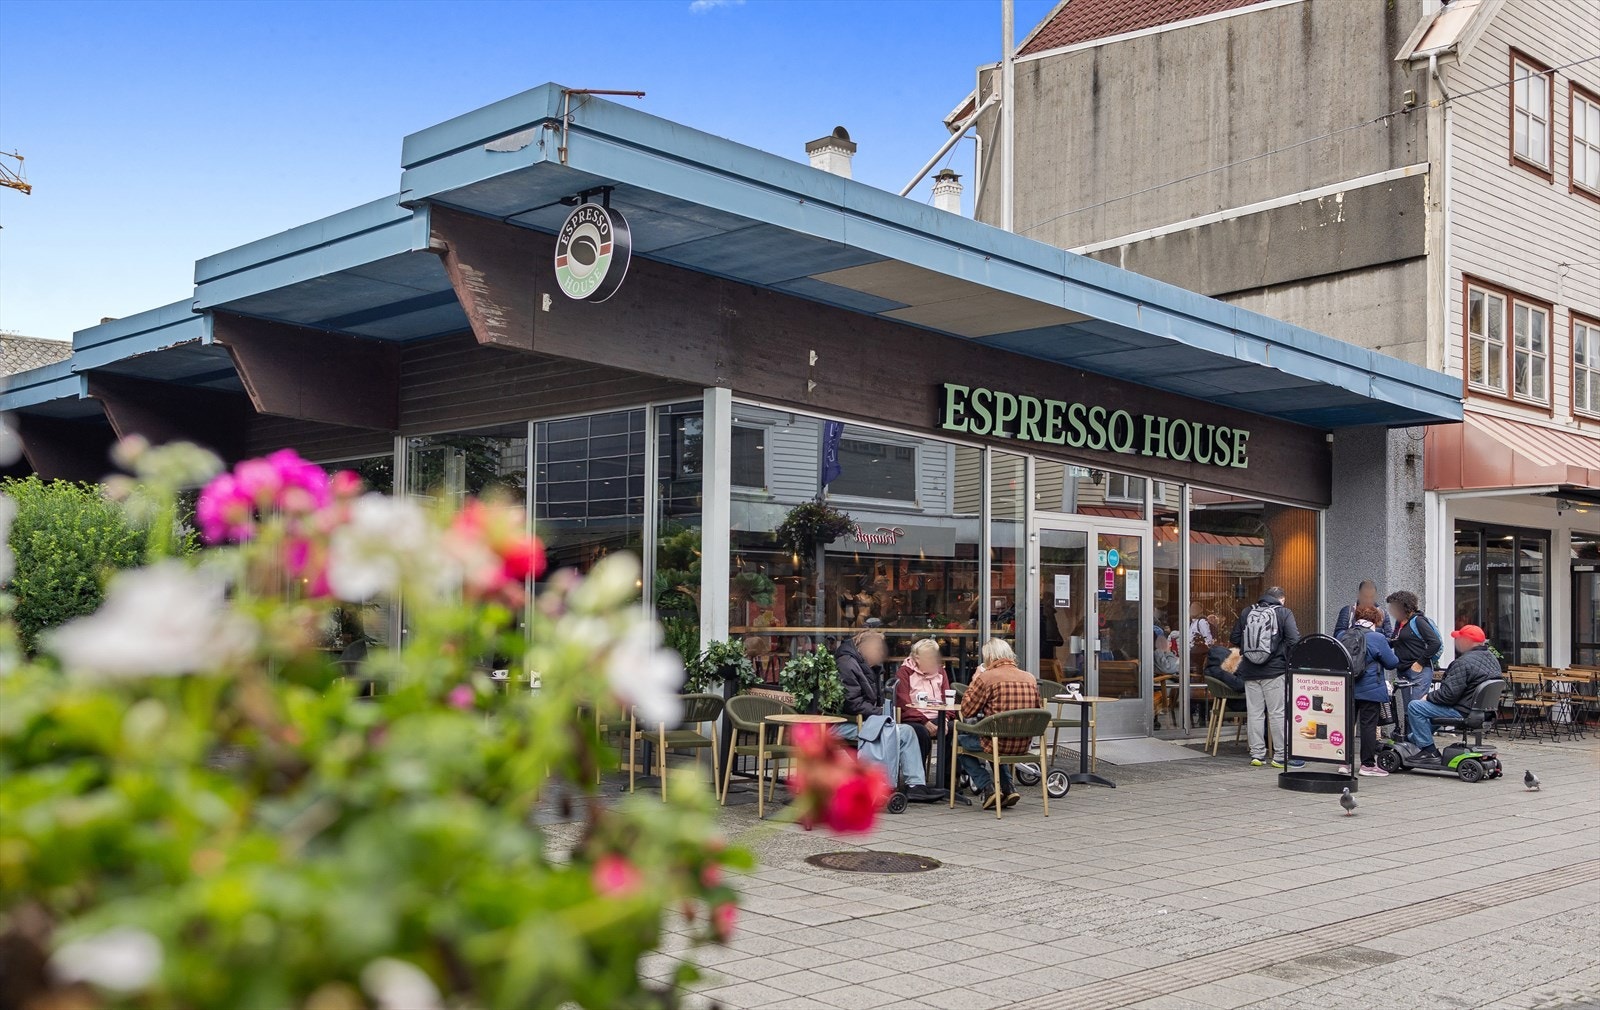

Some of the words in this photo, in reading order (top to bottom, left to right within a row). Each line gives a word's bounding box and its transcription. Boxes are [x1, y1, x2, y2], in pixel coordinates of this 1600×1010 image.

[561, 208, 608, 245] ESPRESSO
[564, 268, 602, 293] HOUSE
[942, 382, 1134, 453] ESPRESSO
[1142, 414, 1250, 469] HOUSE
